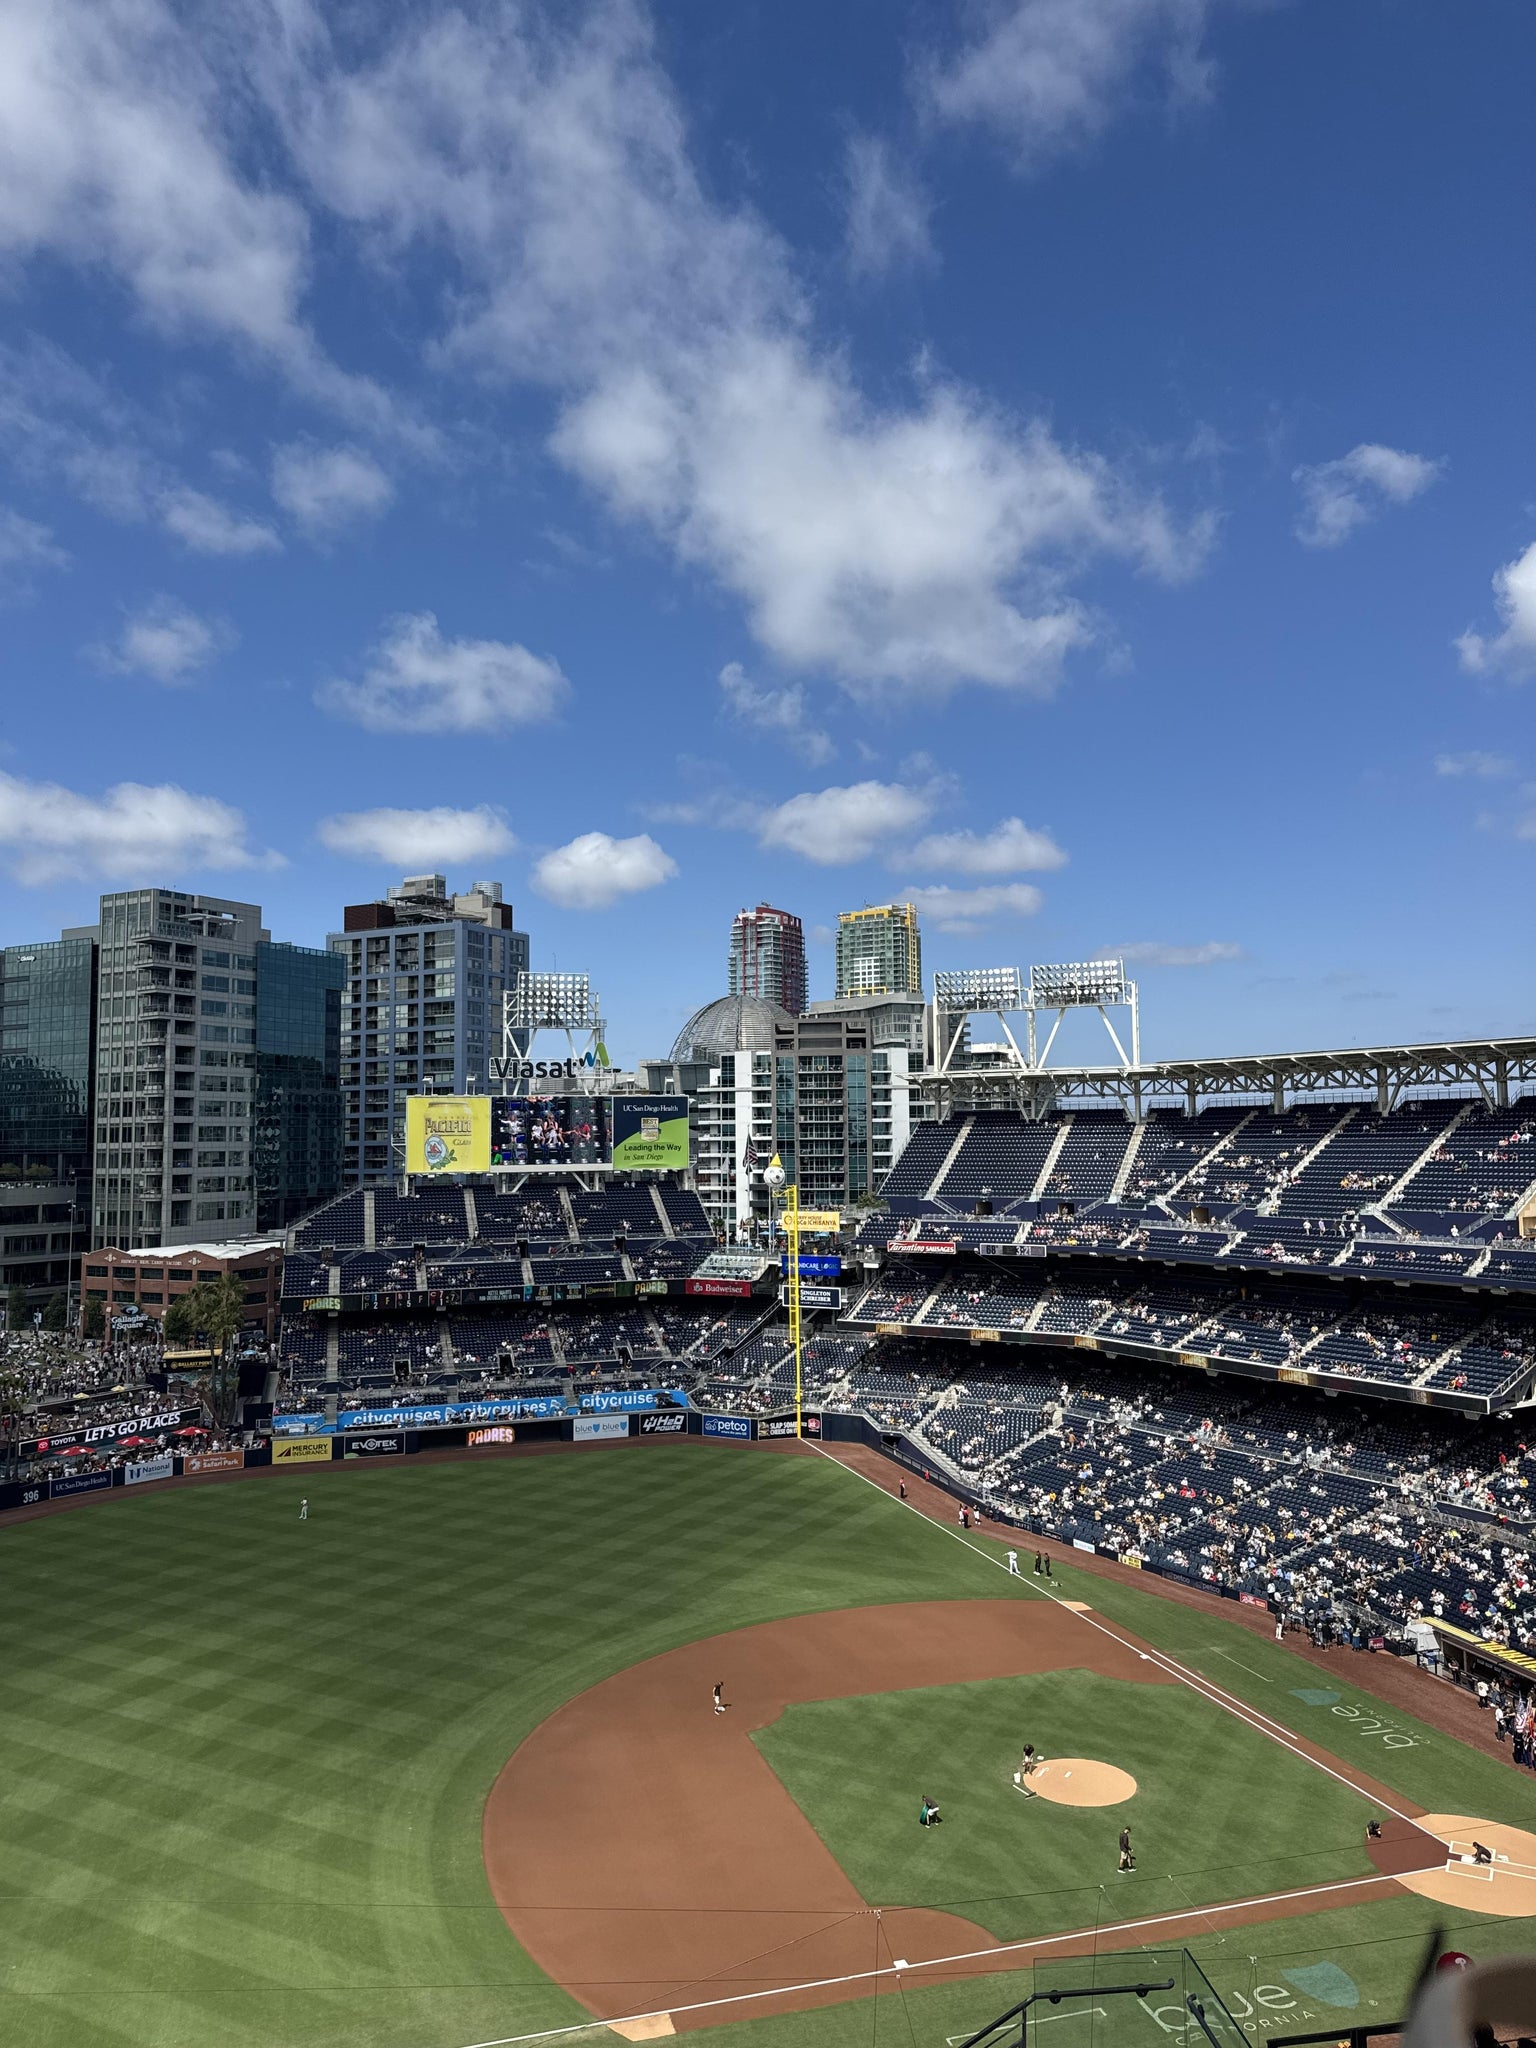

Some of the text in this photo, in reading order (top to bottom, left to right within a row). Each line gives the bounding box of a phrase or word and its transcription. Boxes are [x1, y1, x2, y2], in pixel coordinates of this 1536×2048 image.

[494, 1057, 577, 1079] Viasat
[644, 1105, 660, 1113] Diego
[624, 1144, 653, 1152] Leading
[666, 1144, 682, 1152] Way
[646, 1153, 664, 1161] Diego
[889, 1242, 926, 1253] Tarantino
[635, 1281, 669, 1295] PADRES
[705, 1284, 744, 1294] Budweiser
[800, 1289, 832, 1297] SINGLETON
[800, 1295, 832, 1303] SCHREIBER
[302, 1297, 343, 1312] PADRES
[111, 1314, 149, 1324] Gallagher
[116, 1322, 144, 1332] Square
[582, 1392, 657, 1410] citycruise
[84, 1411, 181, 1443] LET'S GO PLACES
[575, 1424, 593, 1433] blue
[602, 1422, 620, 1431] blue
[654, 1424, 681, 1432] POWER
[717, 1420, 748, 1432] petco
[769, 1421, 783, 1430] SLAP
[467, 1427, 515, 1447] PADRES
[769, 1428, 786, 1436] CHEESE
[50, 1436, 77, 1447] TOYOTA
[292, 1443, 328, 1452] MERCURY
[291, 1449, 328, 1457] INSURANCE
[142, 1462, 170, 1474] National
[203, 1460, 223, 1468] Safari
[55, 1475, 108, 1492] UC San Diego Health
[22, 1490, 40, 1504] 396
[1331, 1705, 1420, 1750] blue
